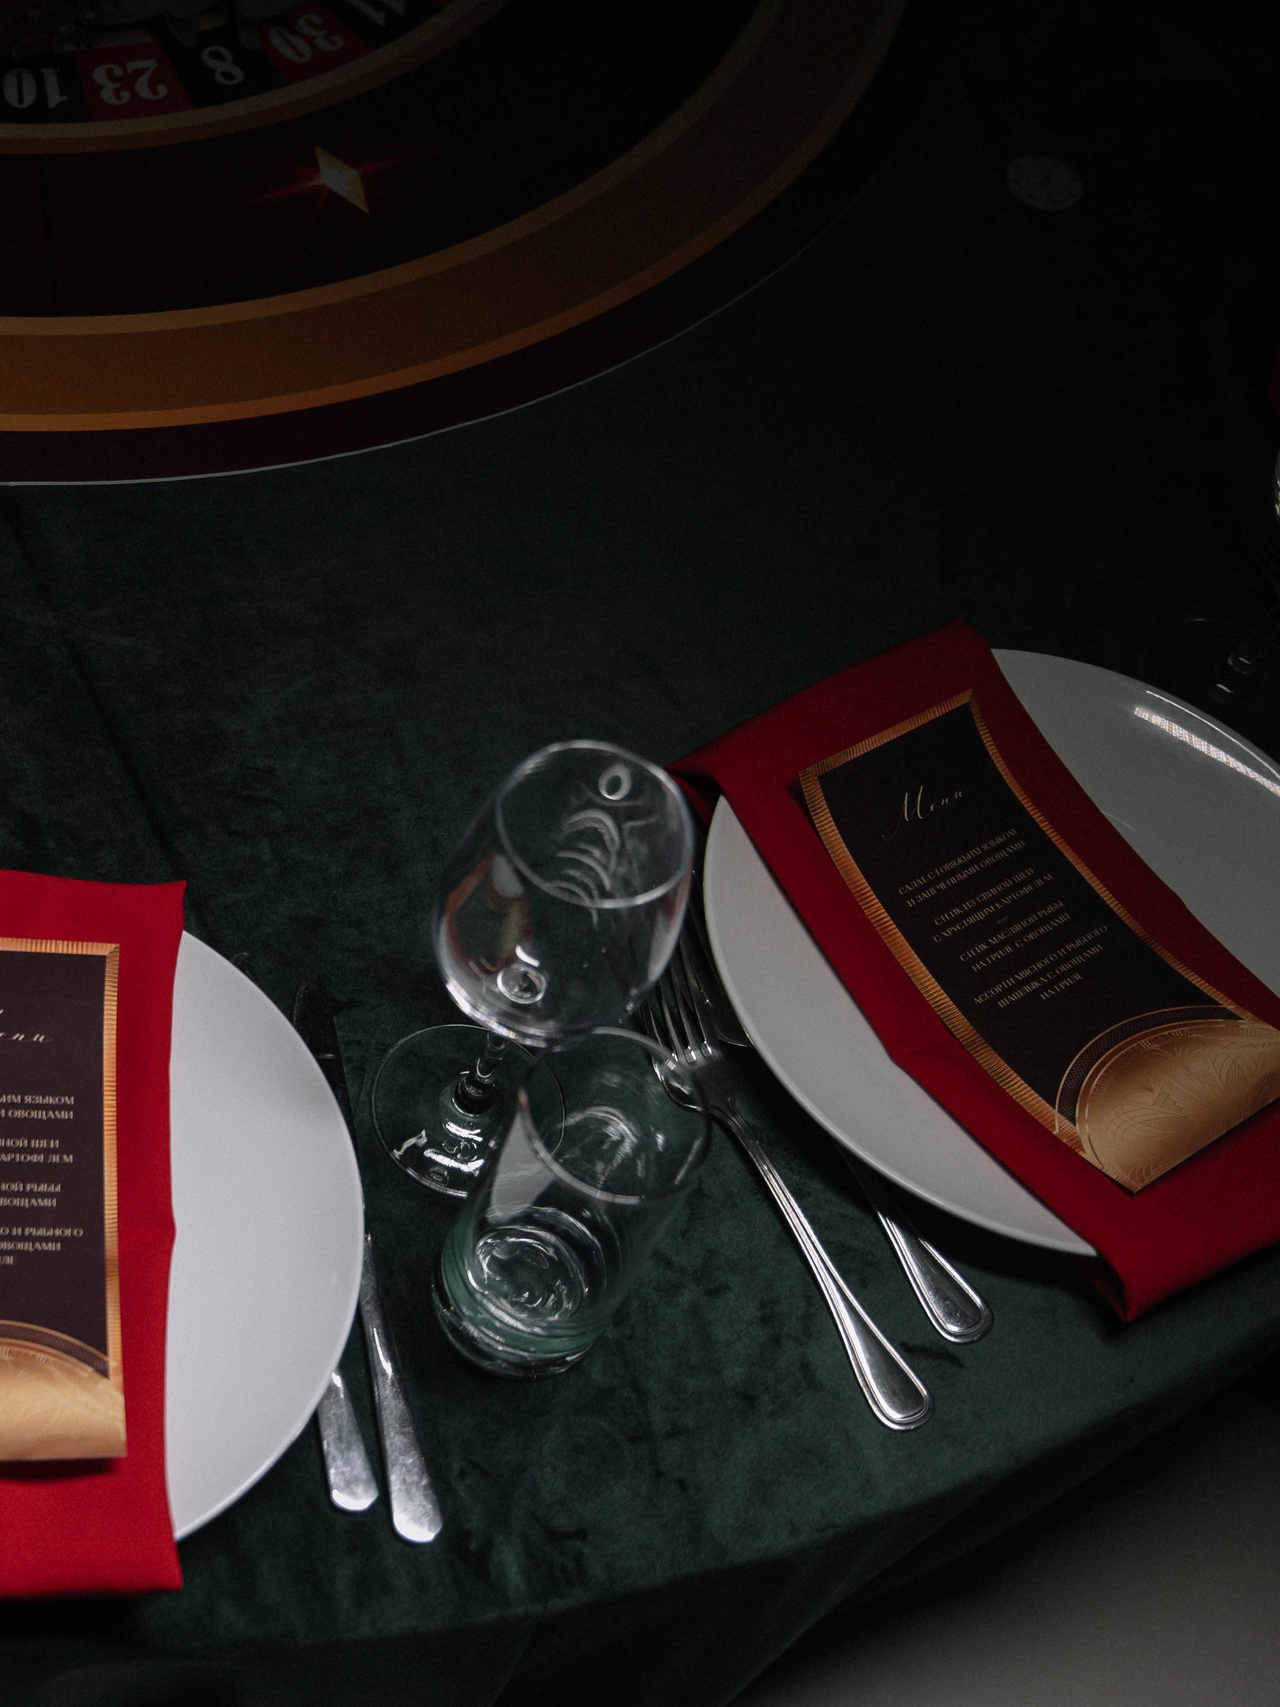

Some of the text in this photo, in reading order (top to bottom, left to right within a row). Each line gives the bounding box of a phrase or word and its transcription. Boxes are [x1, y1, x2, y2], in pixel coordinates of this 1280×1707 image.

[267, 12, 345, 64] 30
[200, 45, 245, 87] 8
[1, 66, 69, 110] 10
[91, 58, 169, 106] 23
[881, 785, 966, 841] Menu
[24, 1094, 75, 1106] ЯЗЫКОМ
[8, 1108, 73, 1121] ОВОЩАМИ
[31, 1138, 59, 1148] ШЕИ
[26, 1182, 61, 1193] РЫБЫ
[12, 1226, 21, 1236] И
[24, 1226, 84, 1238] РЫБНОГО
